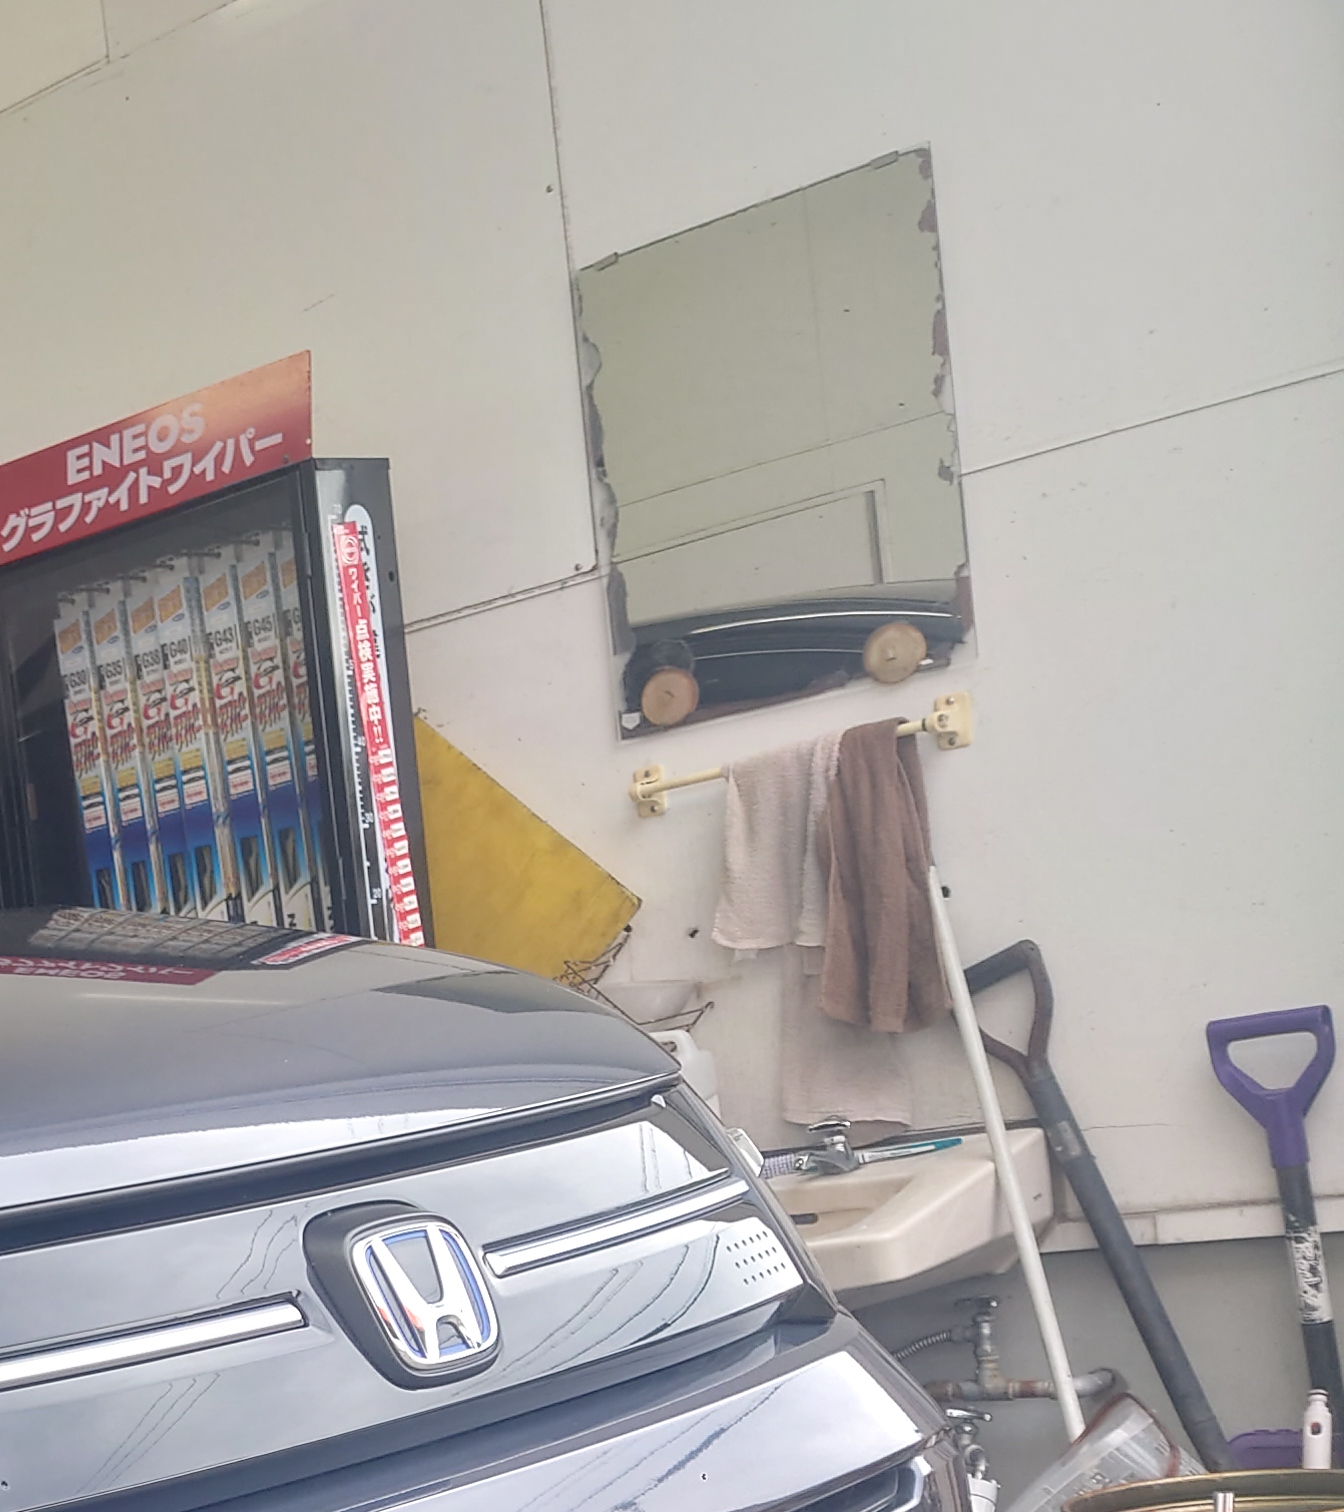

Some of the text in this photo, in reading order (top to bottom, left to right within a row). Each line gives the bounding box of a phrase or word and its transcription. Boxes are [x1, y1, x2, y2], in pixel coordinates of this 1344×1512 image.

[0, 428, 283, 552] グラファイトワイパー
[66, 403, 205, 486] ENEOS
